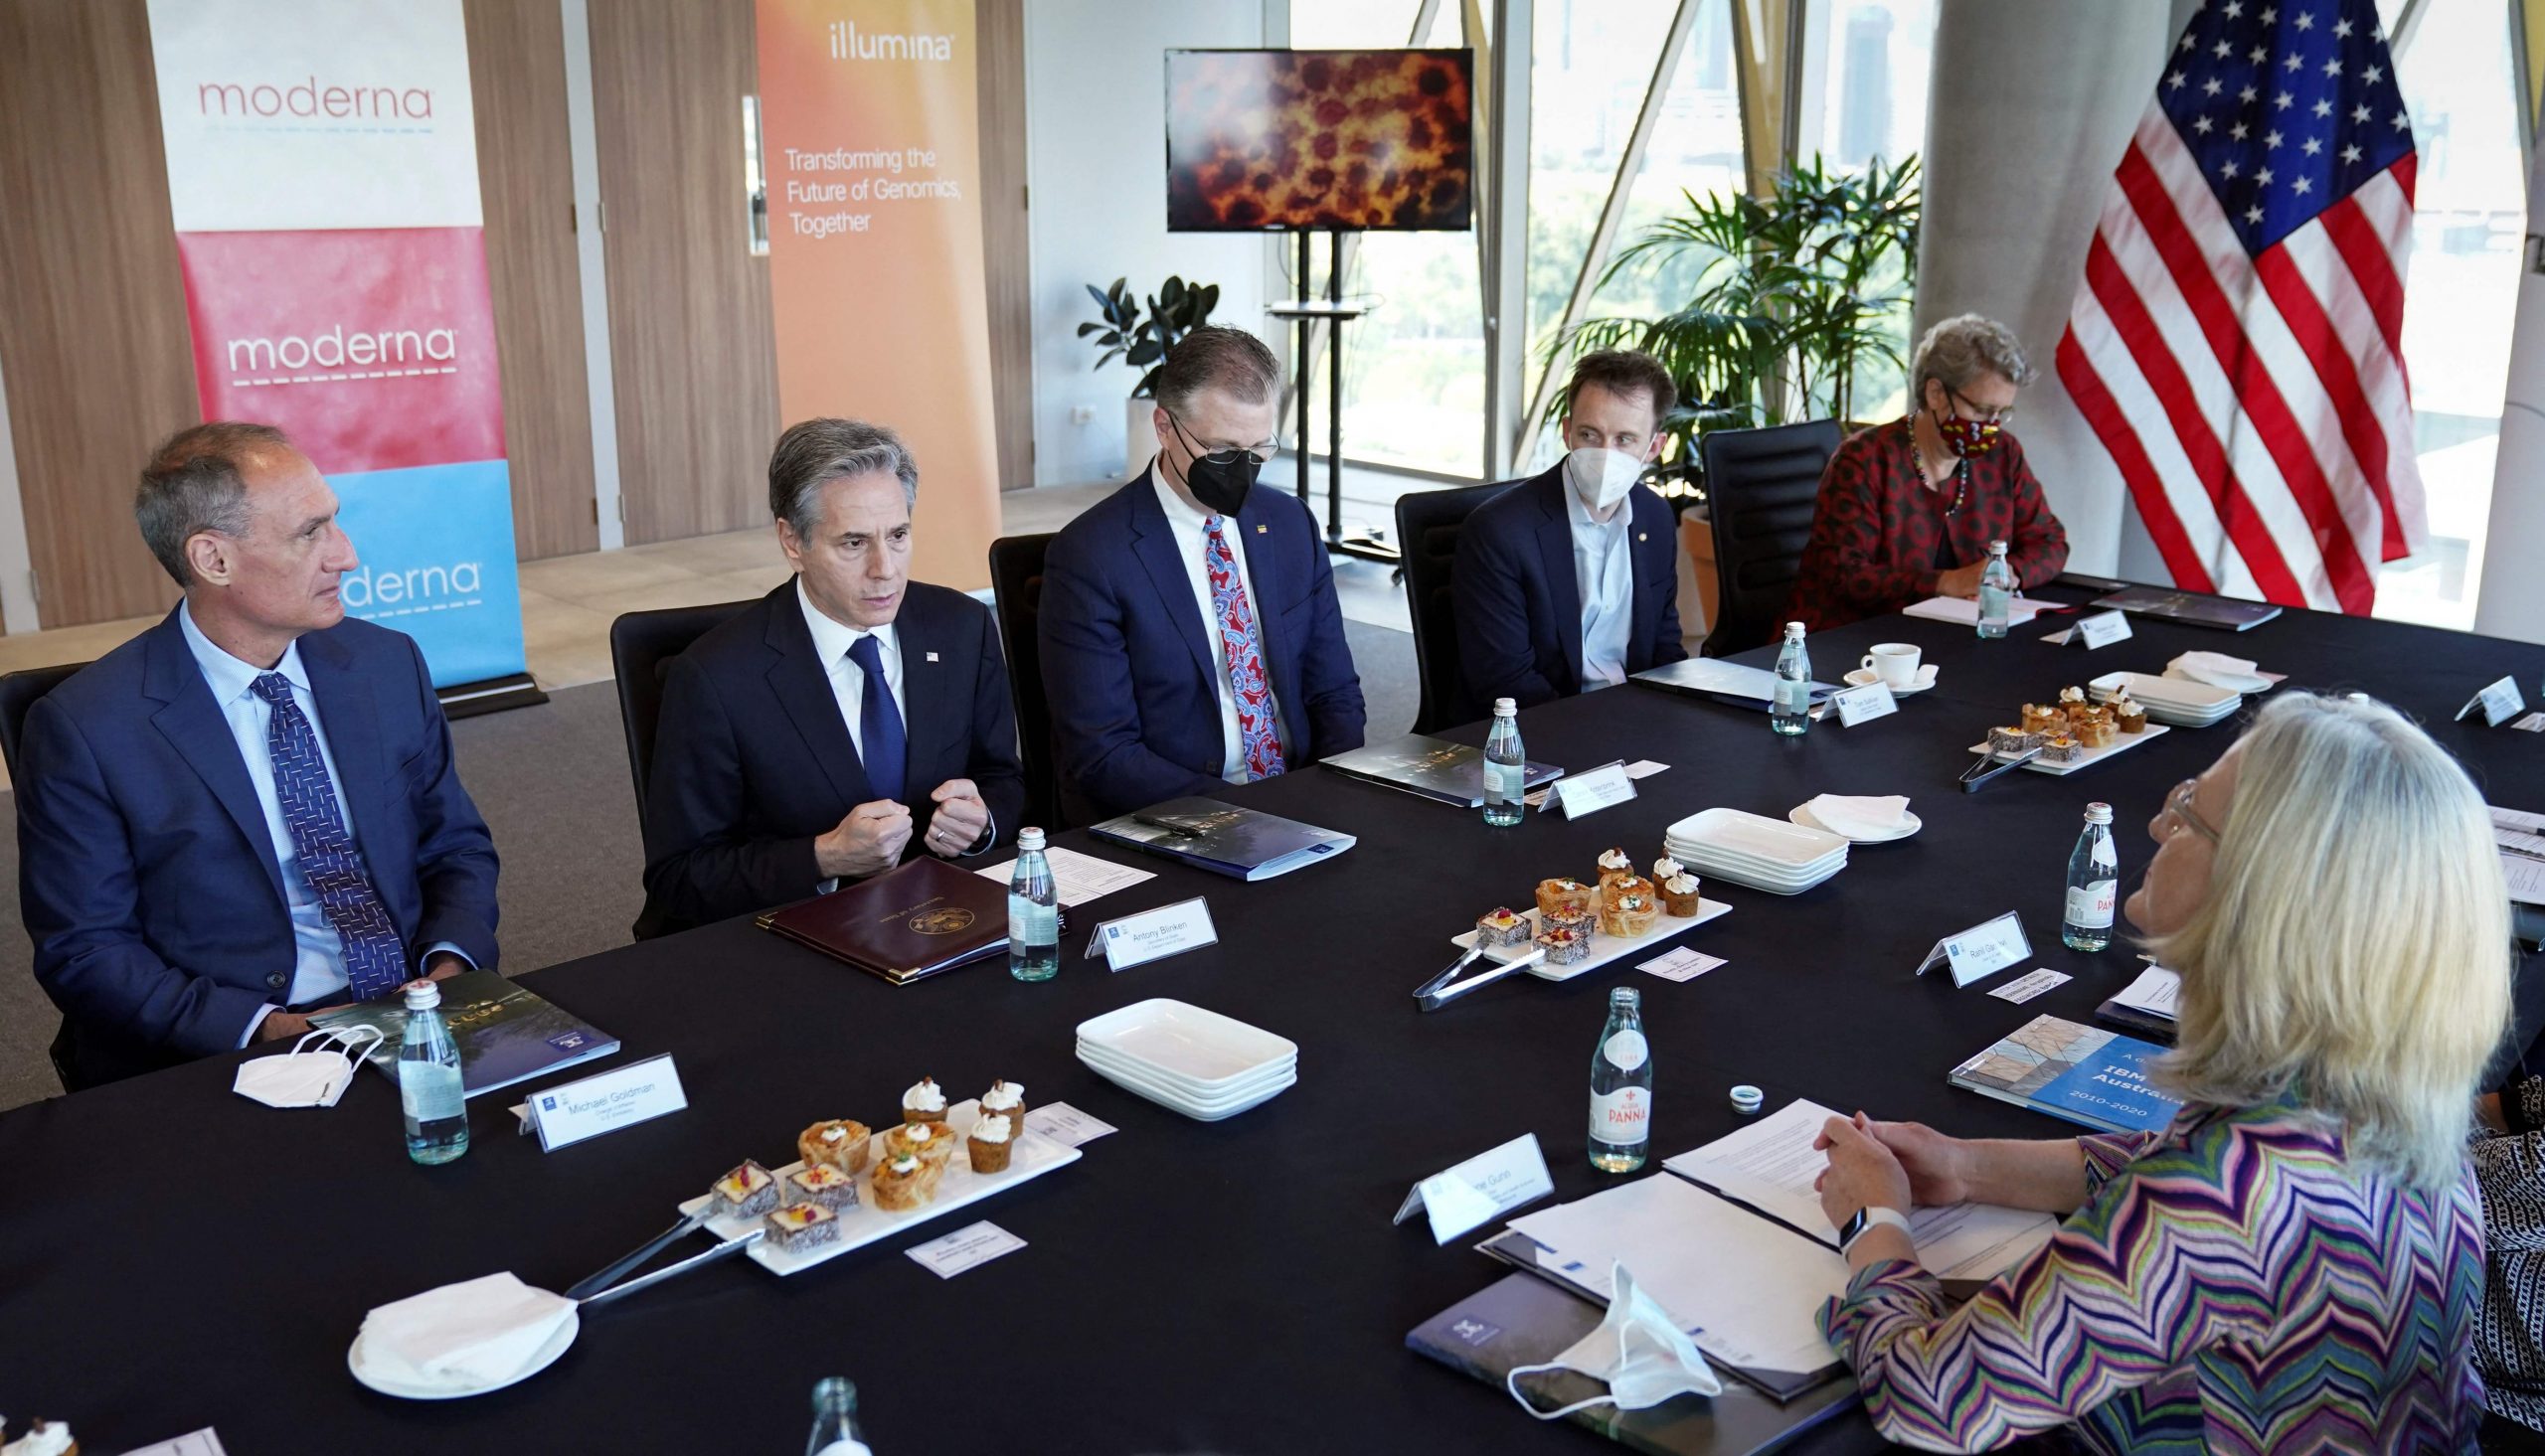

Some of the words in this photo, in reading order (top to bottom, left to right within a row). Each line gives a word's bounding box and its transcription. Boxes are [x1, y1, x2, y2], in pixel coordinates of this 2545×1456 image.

[829, 20, 951, 61] illumina
[199, 76, 432, 119] moderna
[784, 148, 903, 174] Transforming
[907, 147, 936, 168] the
[786, 180, 847, 204] Future
[851, 178, 870, 201] of
[873, 177, 962, 202] Genomics,
[788, 212, 872, 239] Together
[227, 324, 456, 373] moderna
[340, 562, 480, 608] derna
[1132, 928, 1159, 942] Antony
[1160, 921, 1187, 934] Blinken
[2103, 1064, 2147, 1083] IBM
[568, 1097, 609, 1114] Michael
[610, 1082, 655, 1101] Goldman
[2070, 1090, 2147, 1116] 2010-2020
[1609, 1107, 1645, 1123] PANNA
[1487, 1170, 1511, 1185] Gunn
